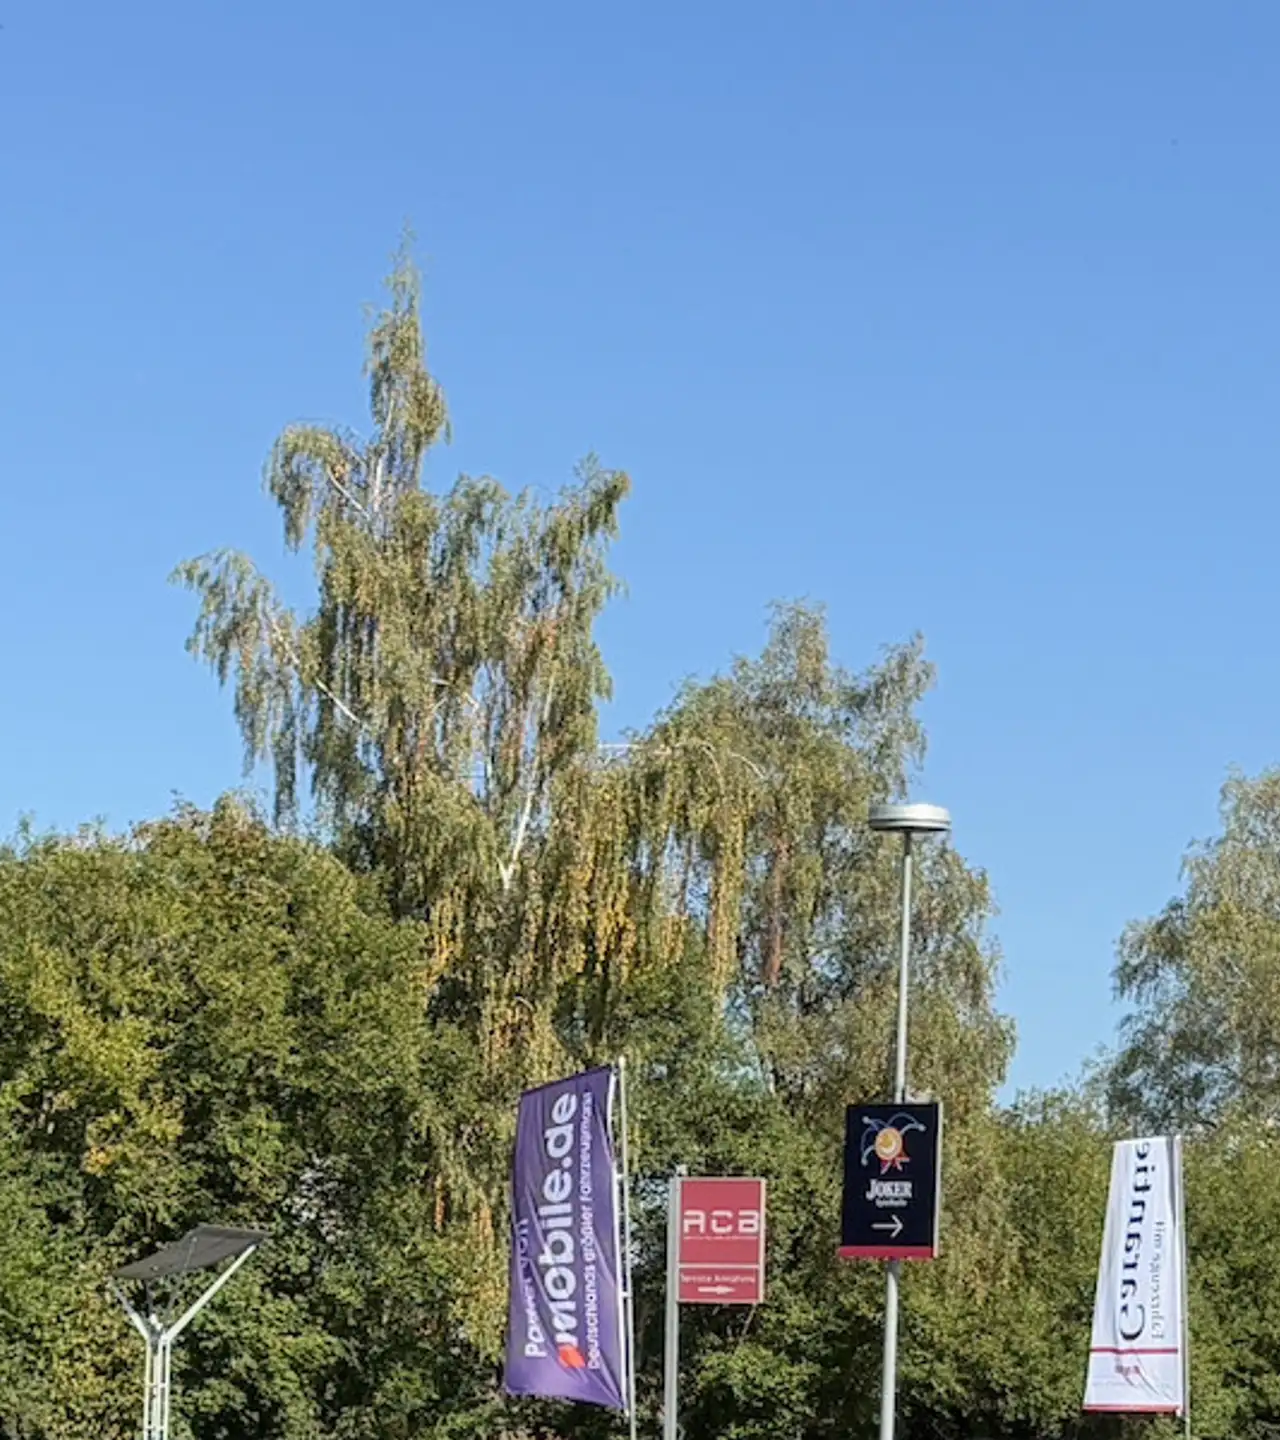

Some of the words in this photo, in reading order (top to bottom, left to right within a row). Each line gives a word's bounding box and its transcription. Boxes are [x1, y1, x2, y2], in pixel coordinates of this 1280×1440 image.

[538, 1092, 578, 1347] mobile.de
[864, 1178, 913, 1200] JOKER
[583, 1264, 601, 1370] Deutschlands
